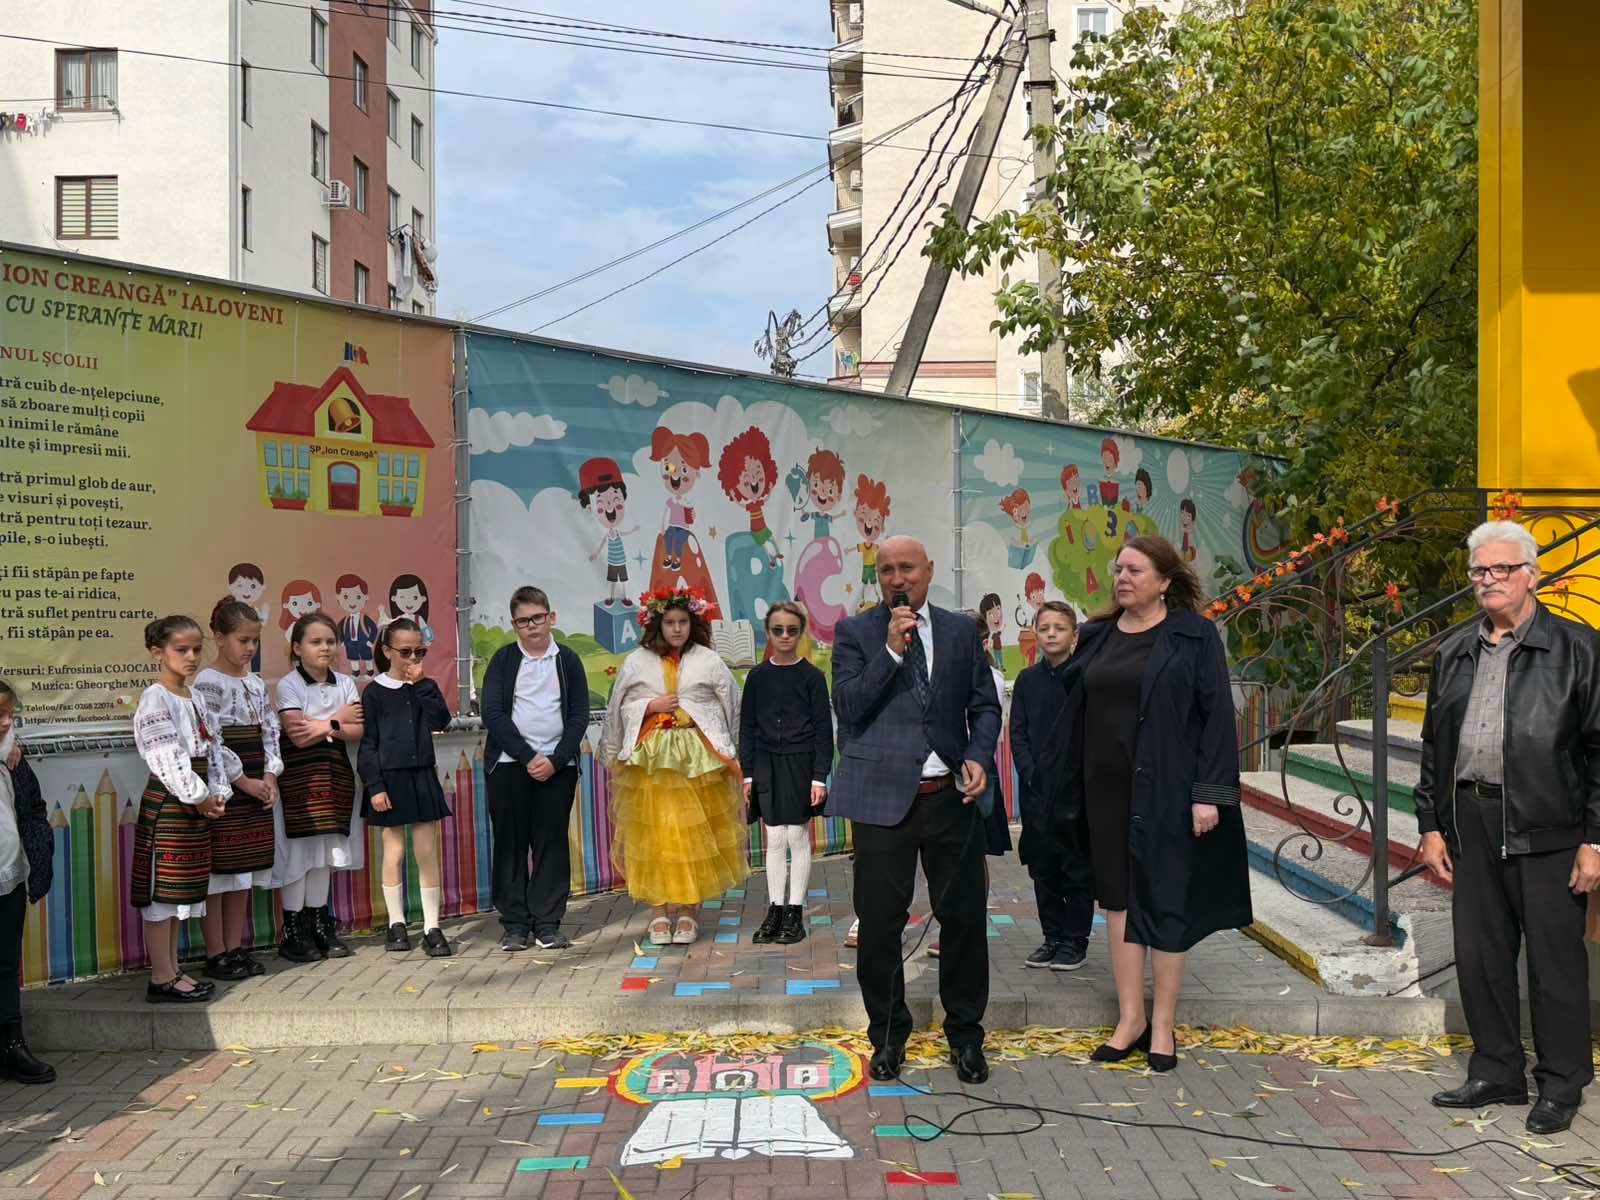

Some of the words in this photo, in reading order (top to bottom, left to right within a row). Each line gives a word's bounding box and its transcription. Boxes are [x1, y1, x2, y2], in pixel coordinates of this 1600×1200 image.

[2, 263, 49, 288] ION
[55, 271, 177, 306] CREANGĂ”
[182, 292, 284, 325] IALOVENI
[6, 294, 35, 314] CU
[42, 299, 143, 334] SPERANȚE
[148, 314, 203, 339] MARI!
[42, 351, 99, 370] ȘCOLII
[25, 380, 57, 392] cuib
[60, 382, 164, 407] de-nțelepciune,
[1, 396, 17, 409] să
[20, 398, 69, 413] zboare
[72, 405, 109, 421] mulți
[112, 409, 145, 424] copii
[8, 416, 49, 432] inimi
[52, 420, 64, 433] le
[67, 422, 119, 438] rămâne
[28, 438, 41, 453] și
[45, 439, 102, 456] impresii
[105, 445, 131, 458] mii.
[26, 473, 76, 487] primul
[78, 476, 108, 490] glob
[111, 478, 126, 490] de
[129, 482, 156, 494] aur,
[7, 491, 52, 505] visuri
[56, 494, 67, 509] și
[70, 497, 124, 511] povești,
[26, 513, 76, 527] pentru
[79, 516, 103, 531] toți
[106, 518, 152, 530] tezaur.
[34, 534, 55, 545] s-o
[59, 533, 109, 550] iubești.
[12, 566, 29, 578] fii
[32, 567, 79, 581] stăpân
[82, 570, 98, 582] pe
[101, 568, 135, 582] fapte
[14, 588, 41, 600] pas
[44, 587, 74, 599] te-ai
[78, 587, 121, 600] ridica,
[28, 606, 68, 618] suflet
[72, 608, 116, 621] pentru
[119, 609, 158, 620] carte,
[7, 626, 24, 639] fii
[28, 626, 75, 640] stăpân
[78, 628, 93, 640] pe
[96, 629, 114, 639] ea.
[621, 619, 637, 644] A
[48, 664, 102, 675] Eufrosinia
[31, 681, 74, 692] Muzica:
[76, 679, 129, 690] Gheorghe
